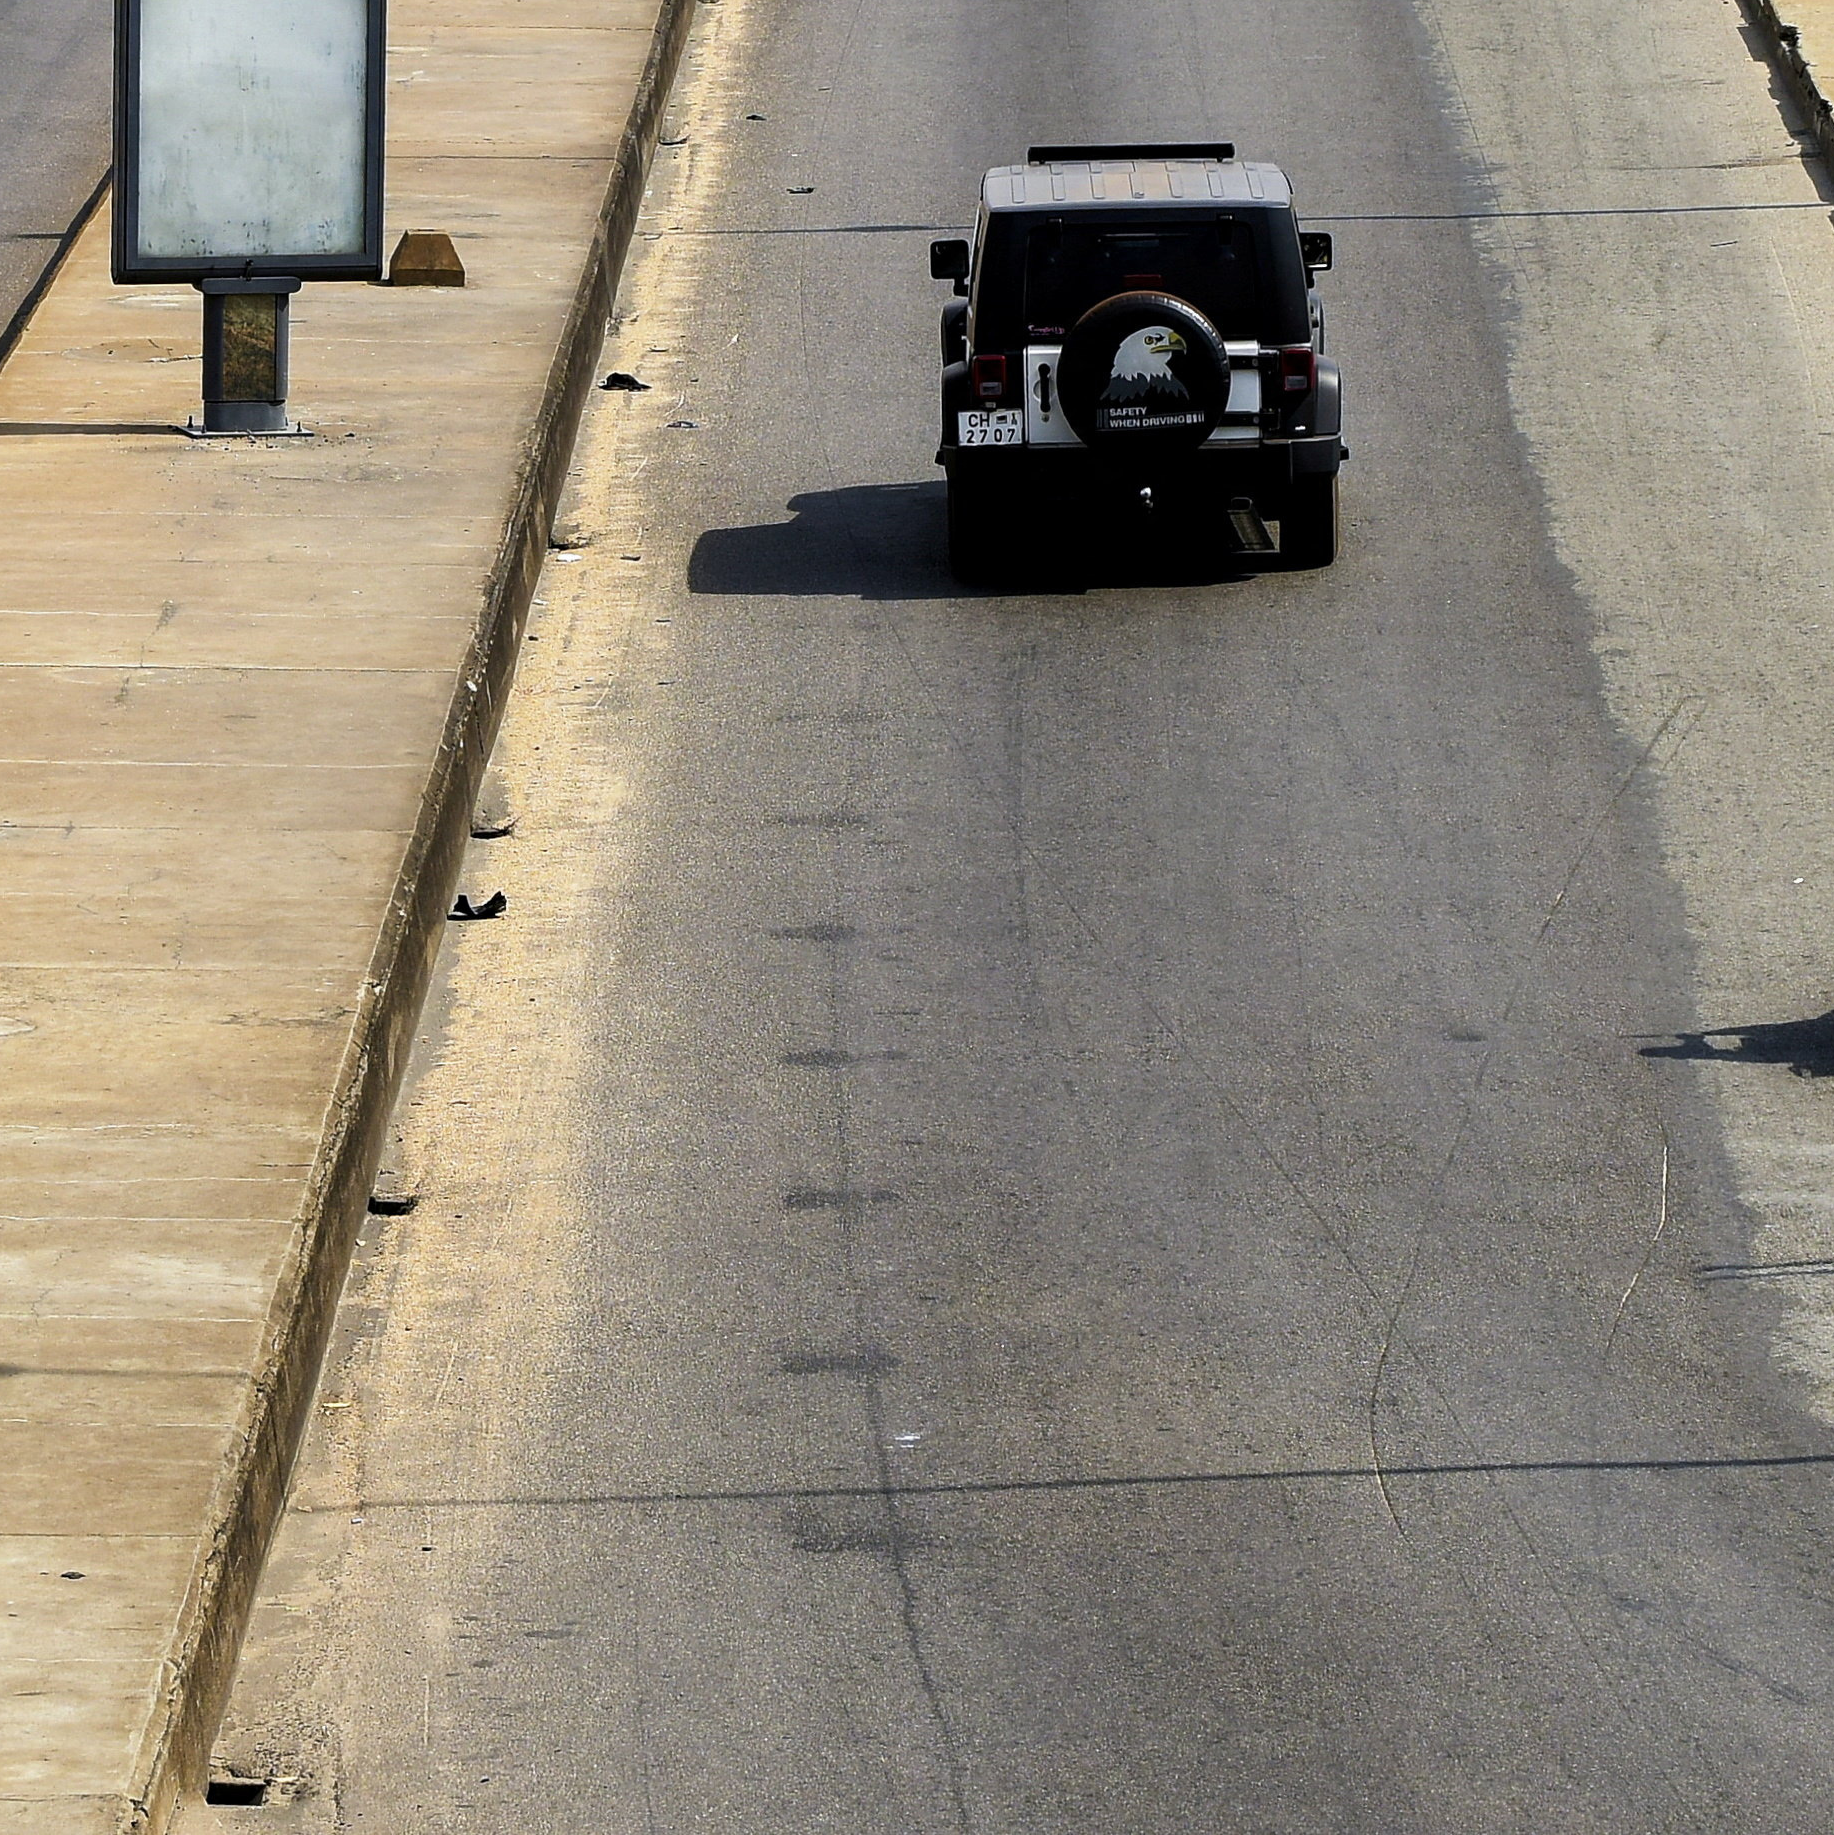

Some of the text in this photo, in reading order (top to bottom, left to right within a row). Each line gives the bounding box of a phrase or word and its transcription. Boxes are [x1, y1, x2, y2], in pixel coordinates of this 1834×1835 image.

[1109, 406, 1147, 417] SAFETY
[968, 413, 990, 428] CH
[1109, 415, 1185, 428] WHEN DRIVING
[966, 428, 1016, 444] 2707
